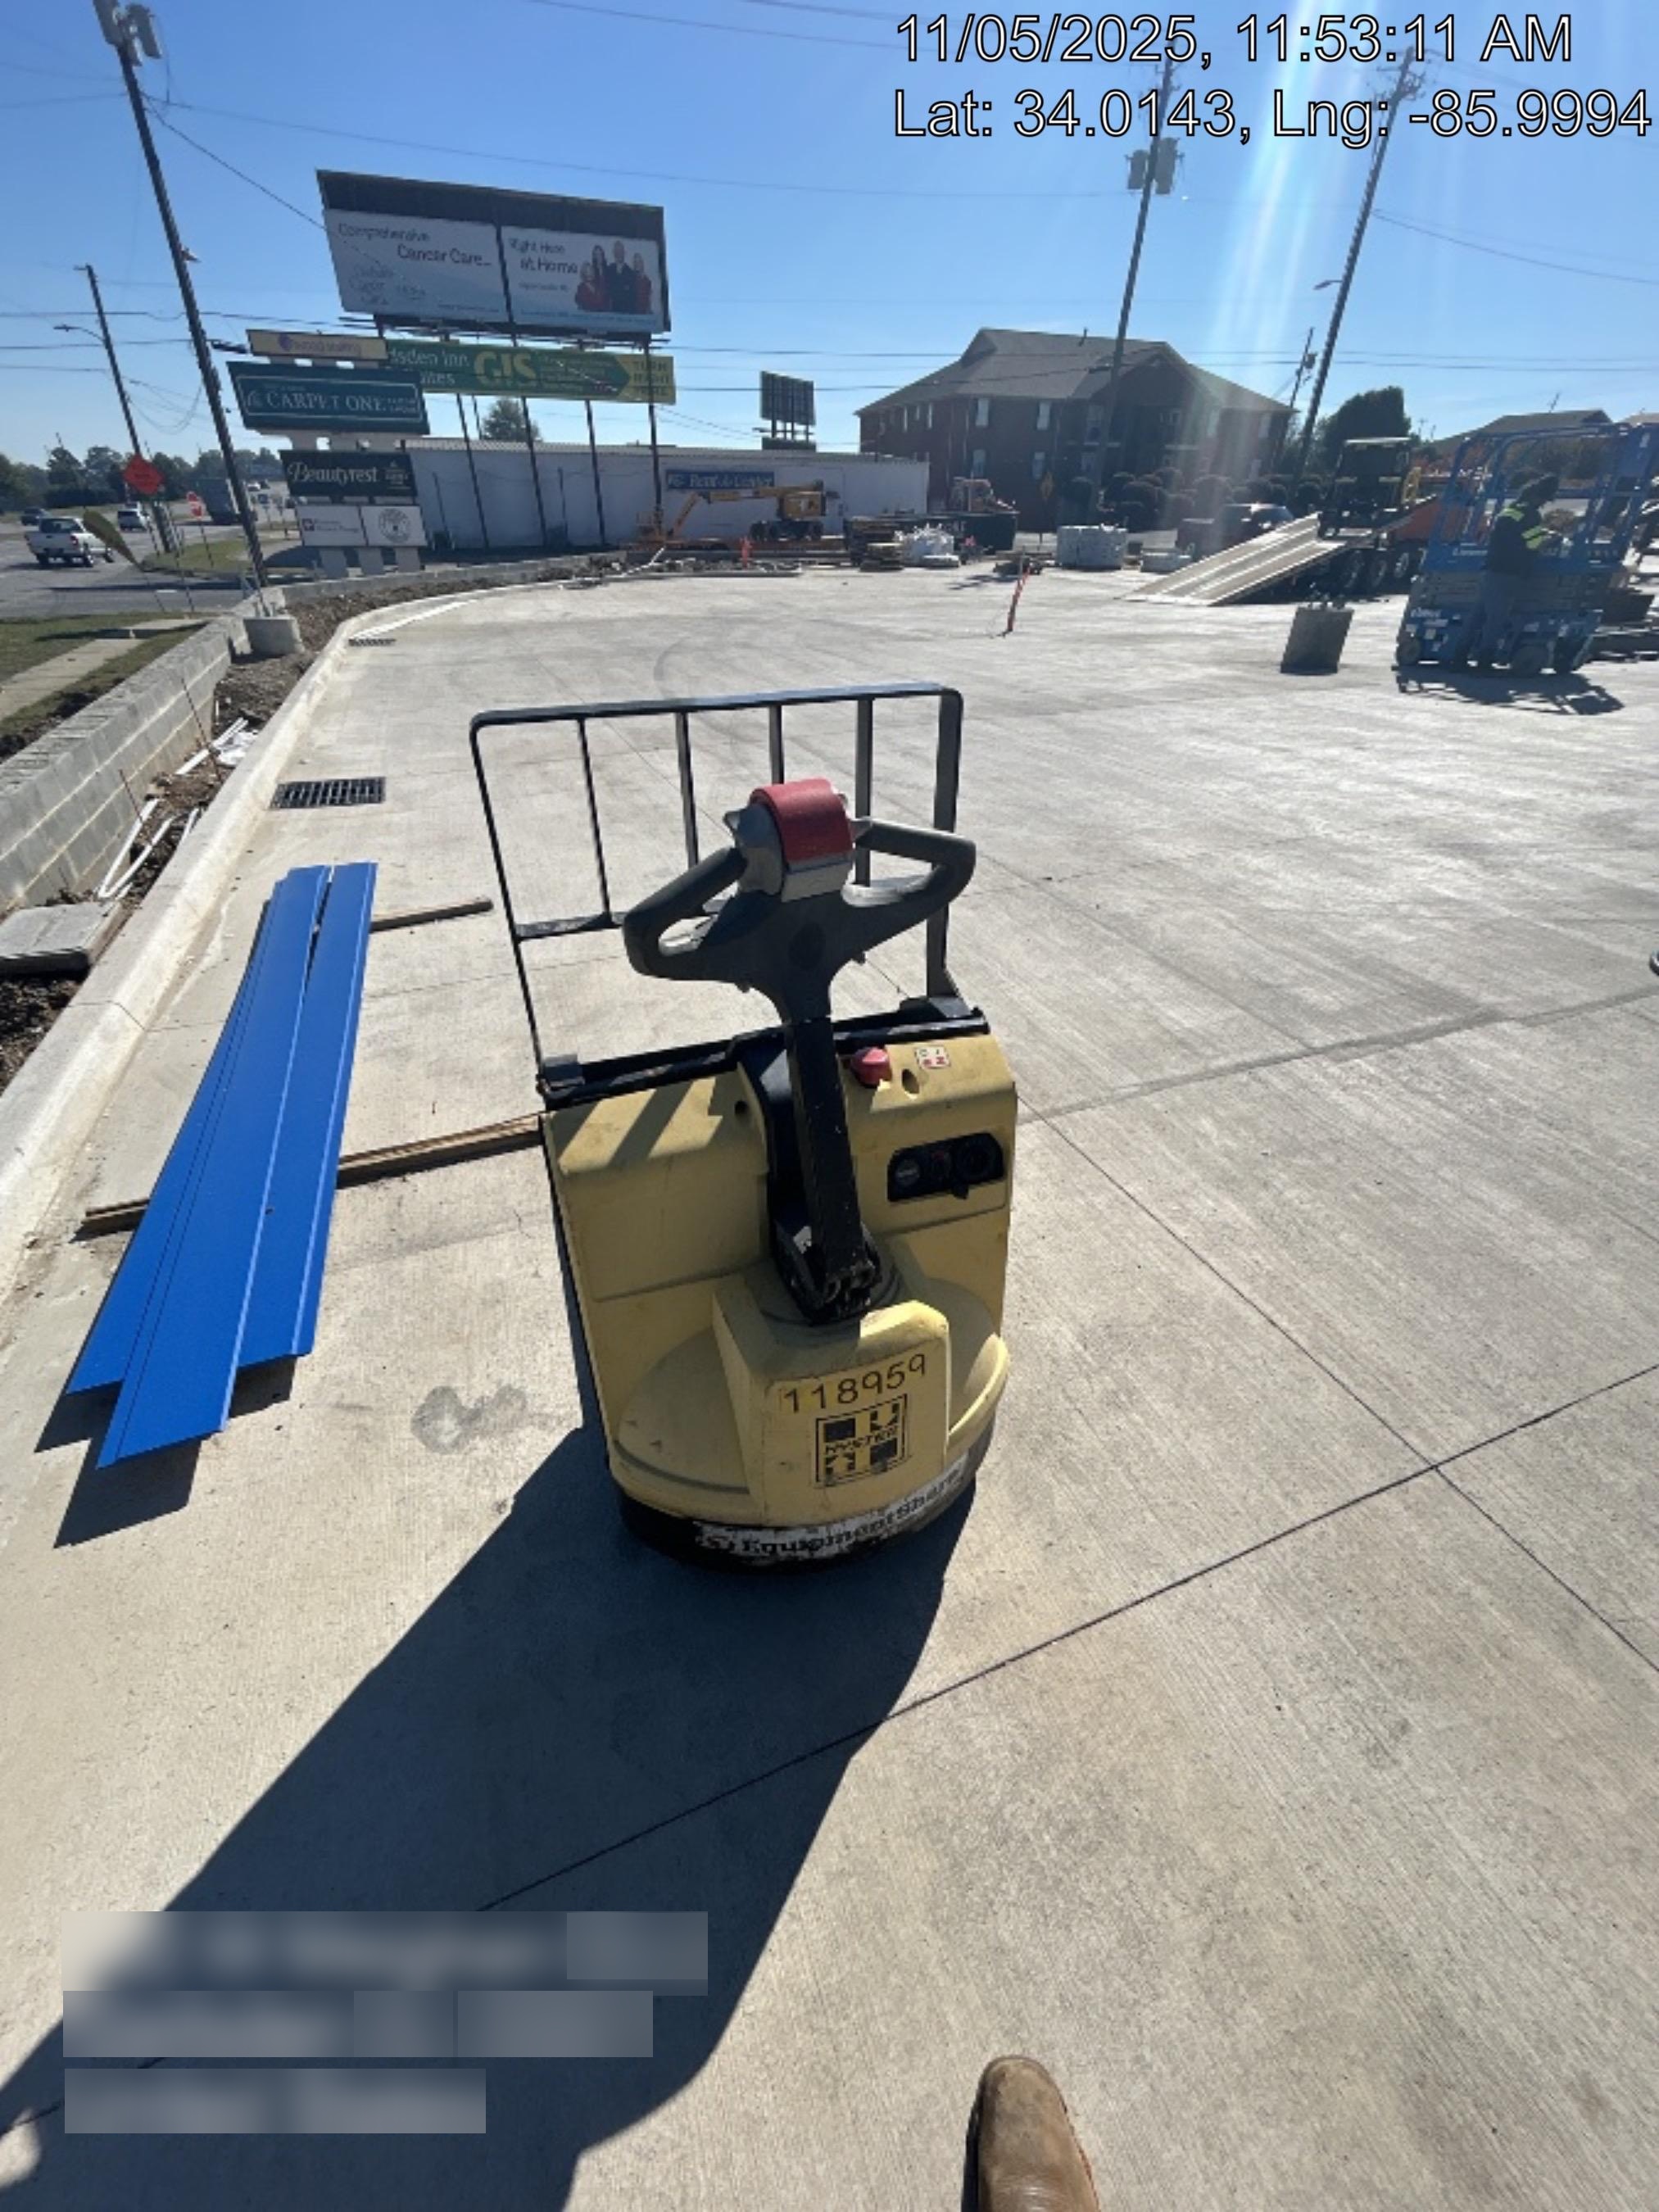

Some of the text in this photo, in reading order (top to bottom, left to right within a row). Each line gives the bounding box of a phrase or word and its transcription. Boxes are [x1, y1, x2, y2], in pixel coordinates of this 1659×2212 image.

[397, 244, 448, 263] Cancer
[266, 390, 341, 410] CARPET
[288, 460, 378, 486] Beautyrest
[783, 1353, 927, 1413] 118959
